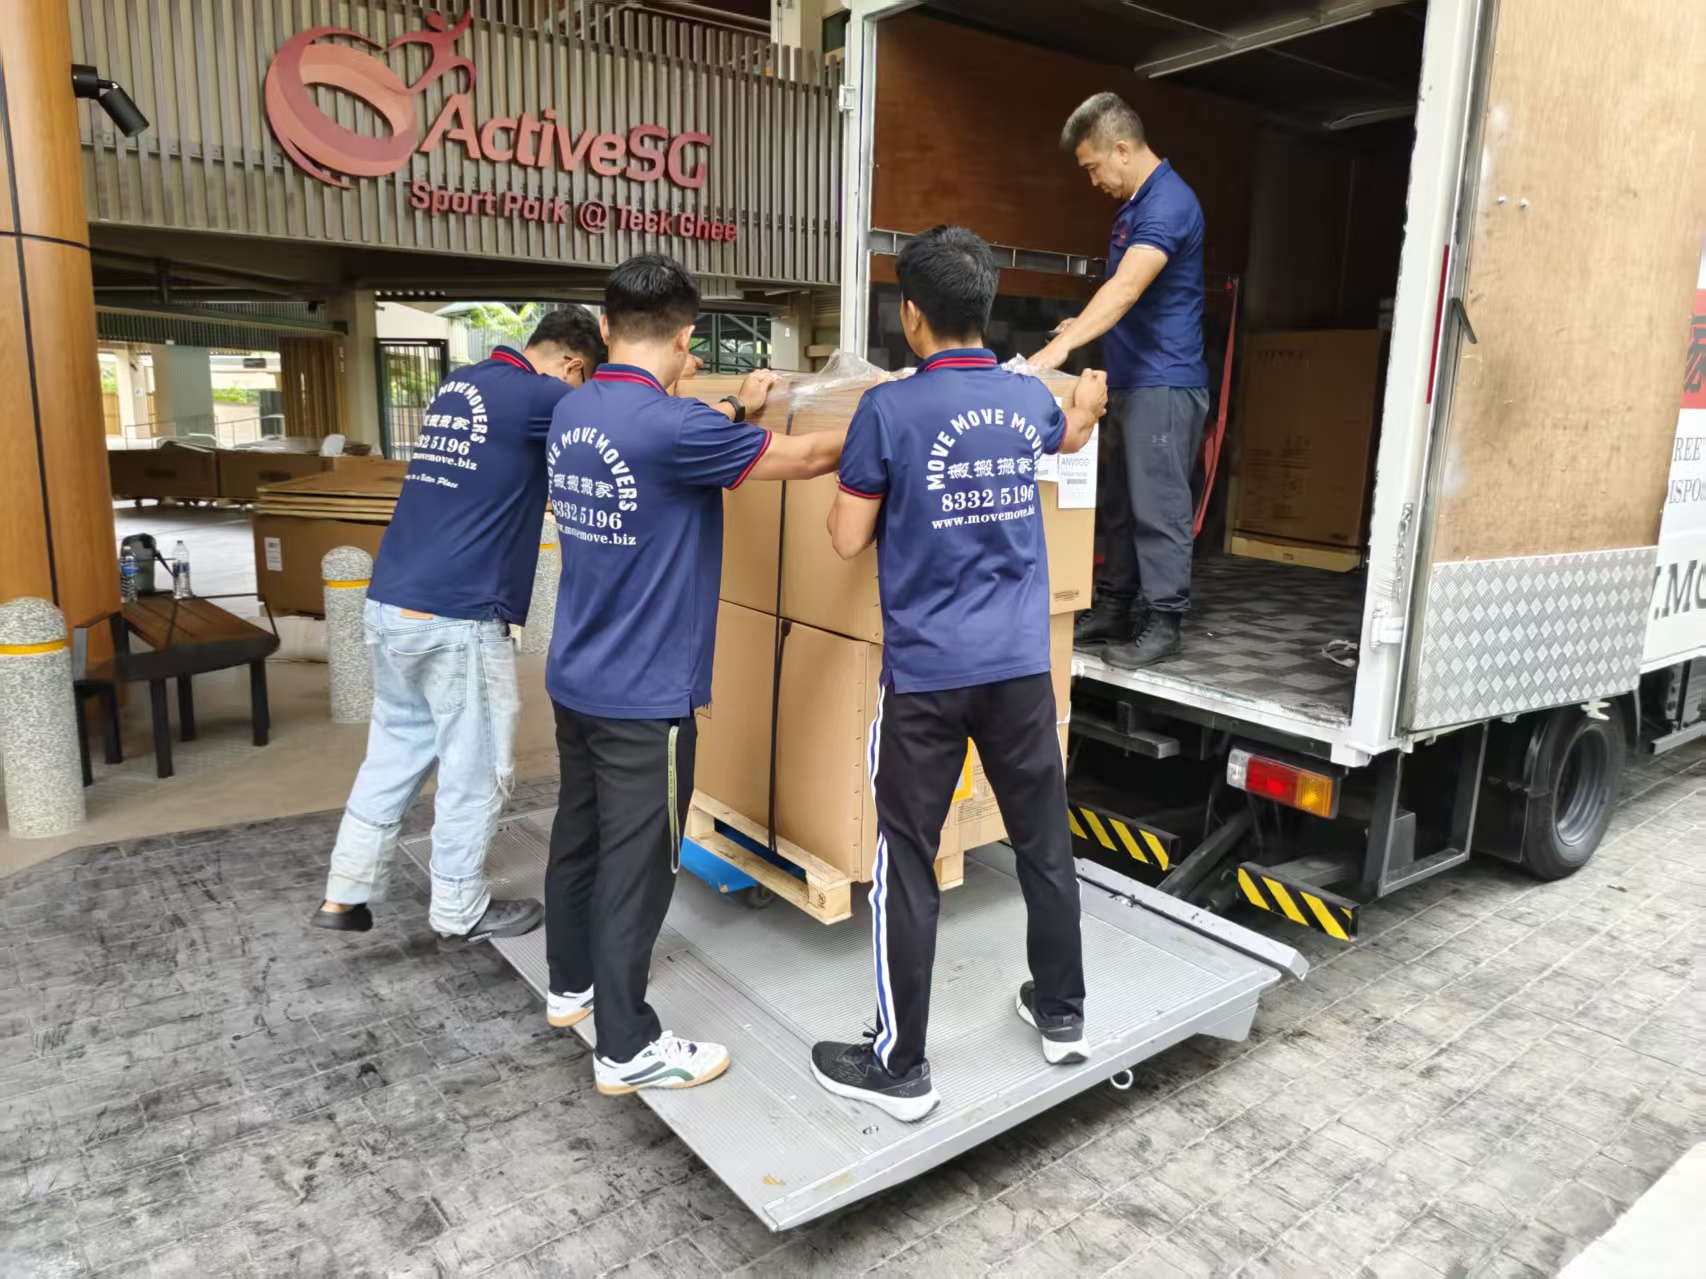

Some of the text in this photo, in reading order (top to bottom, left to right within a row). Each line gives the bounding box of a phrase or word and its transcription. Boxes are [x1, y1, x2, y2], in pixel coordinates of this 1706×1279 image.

[418, 92, 712, 188] ActiveSG
[410, 180, 738, 241] Sport Park @ Teck Ghee
[464, 384, 488, 443] MOVERS
[430, 436, 471, 456] 5196
[561, 427, 598, 449] MOVE
[595, 433, 638, 512] MOVERS
[926, 430, 956, 490] MOVE
[950, 408, 1004, 435] MOVE
[551, 499, 622, 530] 8332 5196
[931, 503, 1035, 529] www.movemove.bi
[941, 483, 1035, 513] 8332 5196
